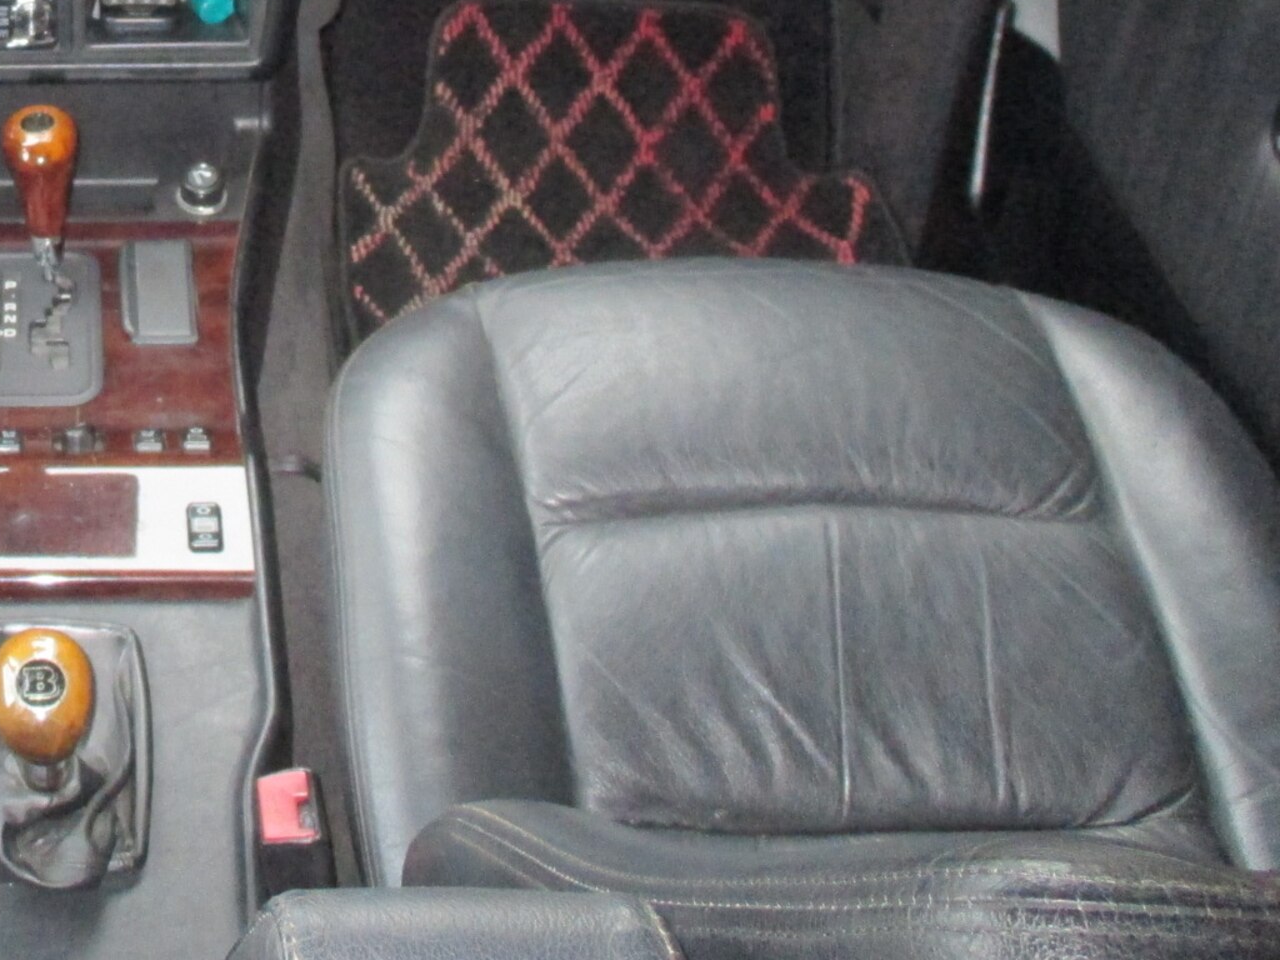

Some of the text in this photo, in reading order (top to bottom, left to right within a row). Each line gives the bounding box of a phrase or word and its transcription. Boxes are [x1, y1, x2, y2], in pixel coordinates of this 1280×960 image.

[3, 314, 17, 323] N
[3, 328, 17, 338] D
[22, 665, 58, 701] B
